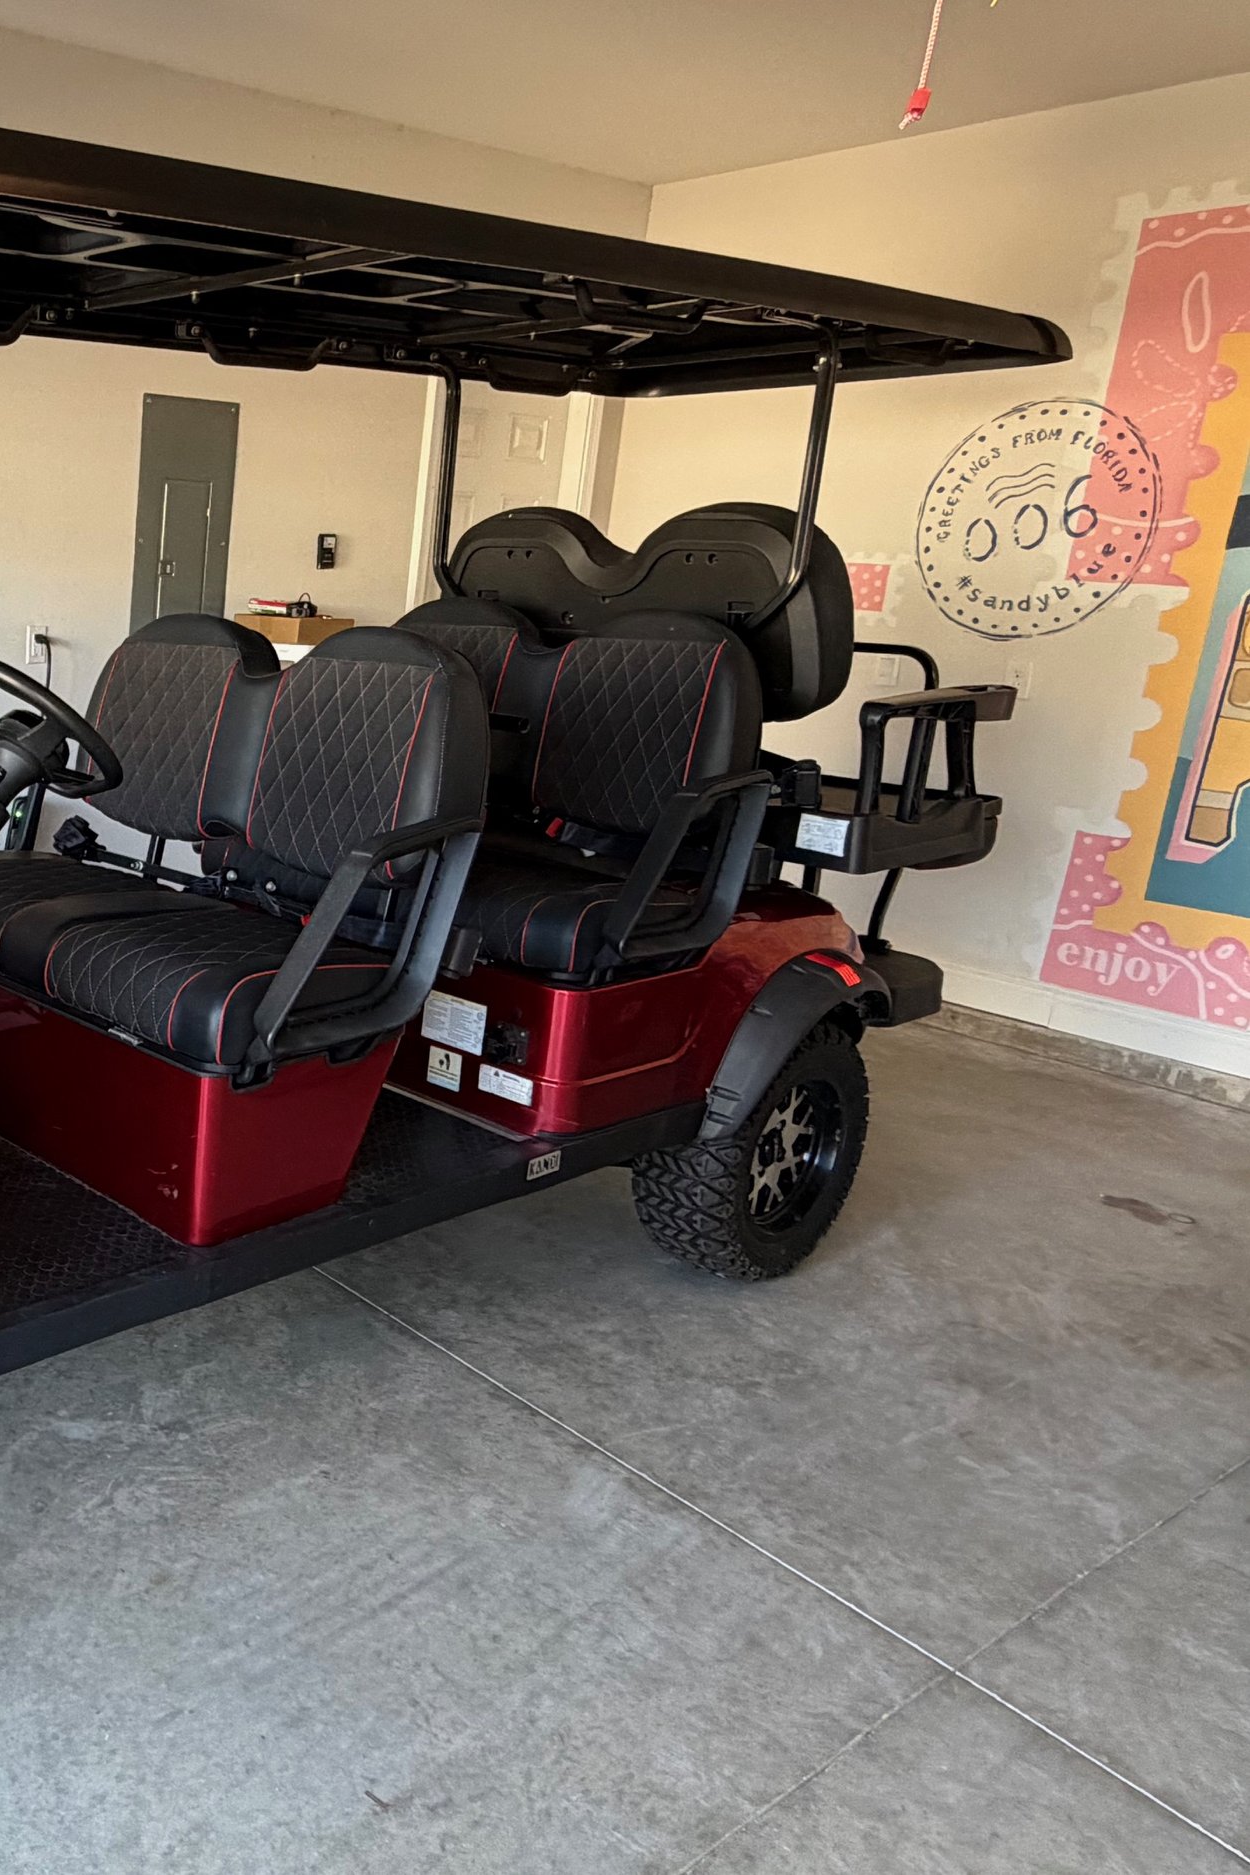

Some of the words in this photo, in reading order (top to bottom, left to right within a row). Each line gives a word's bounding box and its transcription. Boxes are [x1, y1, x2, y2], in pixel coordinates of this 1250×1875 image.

[937, 447, 1001, 542] GREETINGS
[1012, 428, 1063, 449] FROM
[1070, 430, 1133, 493] FLORIDA
[1057, 942, 1183, 996] enjoy
